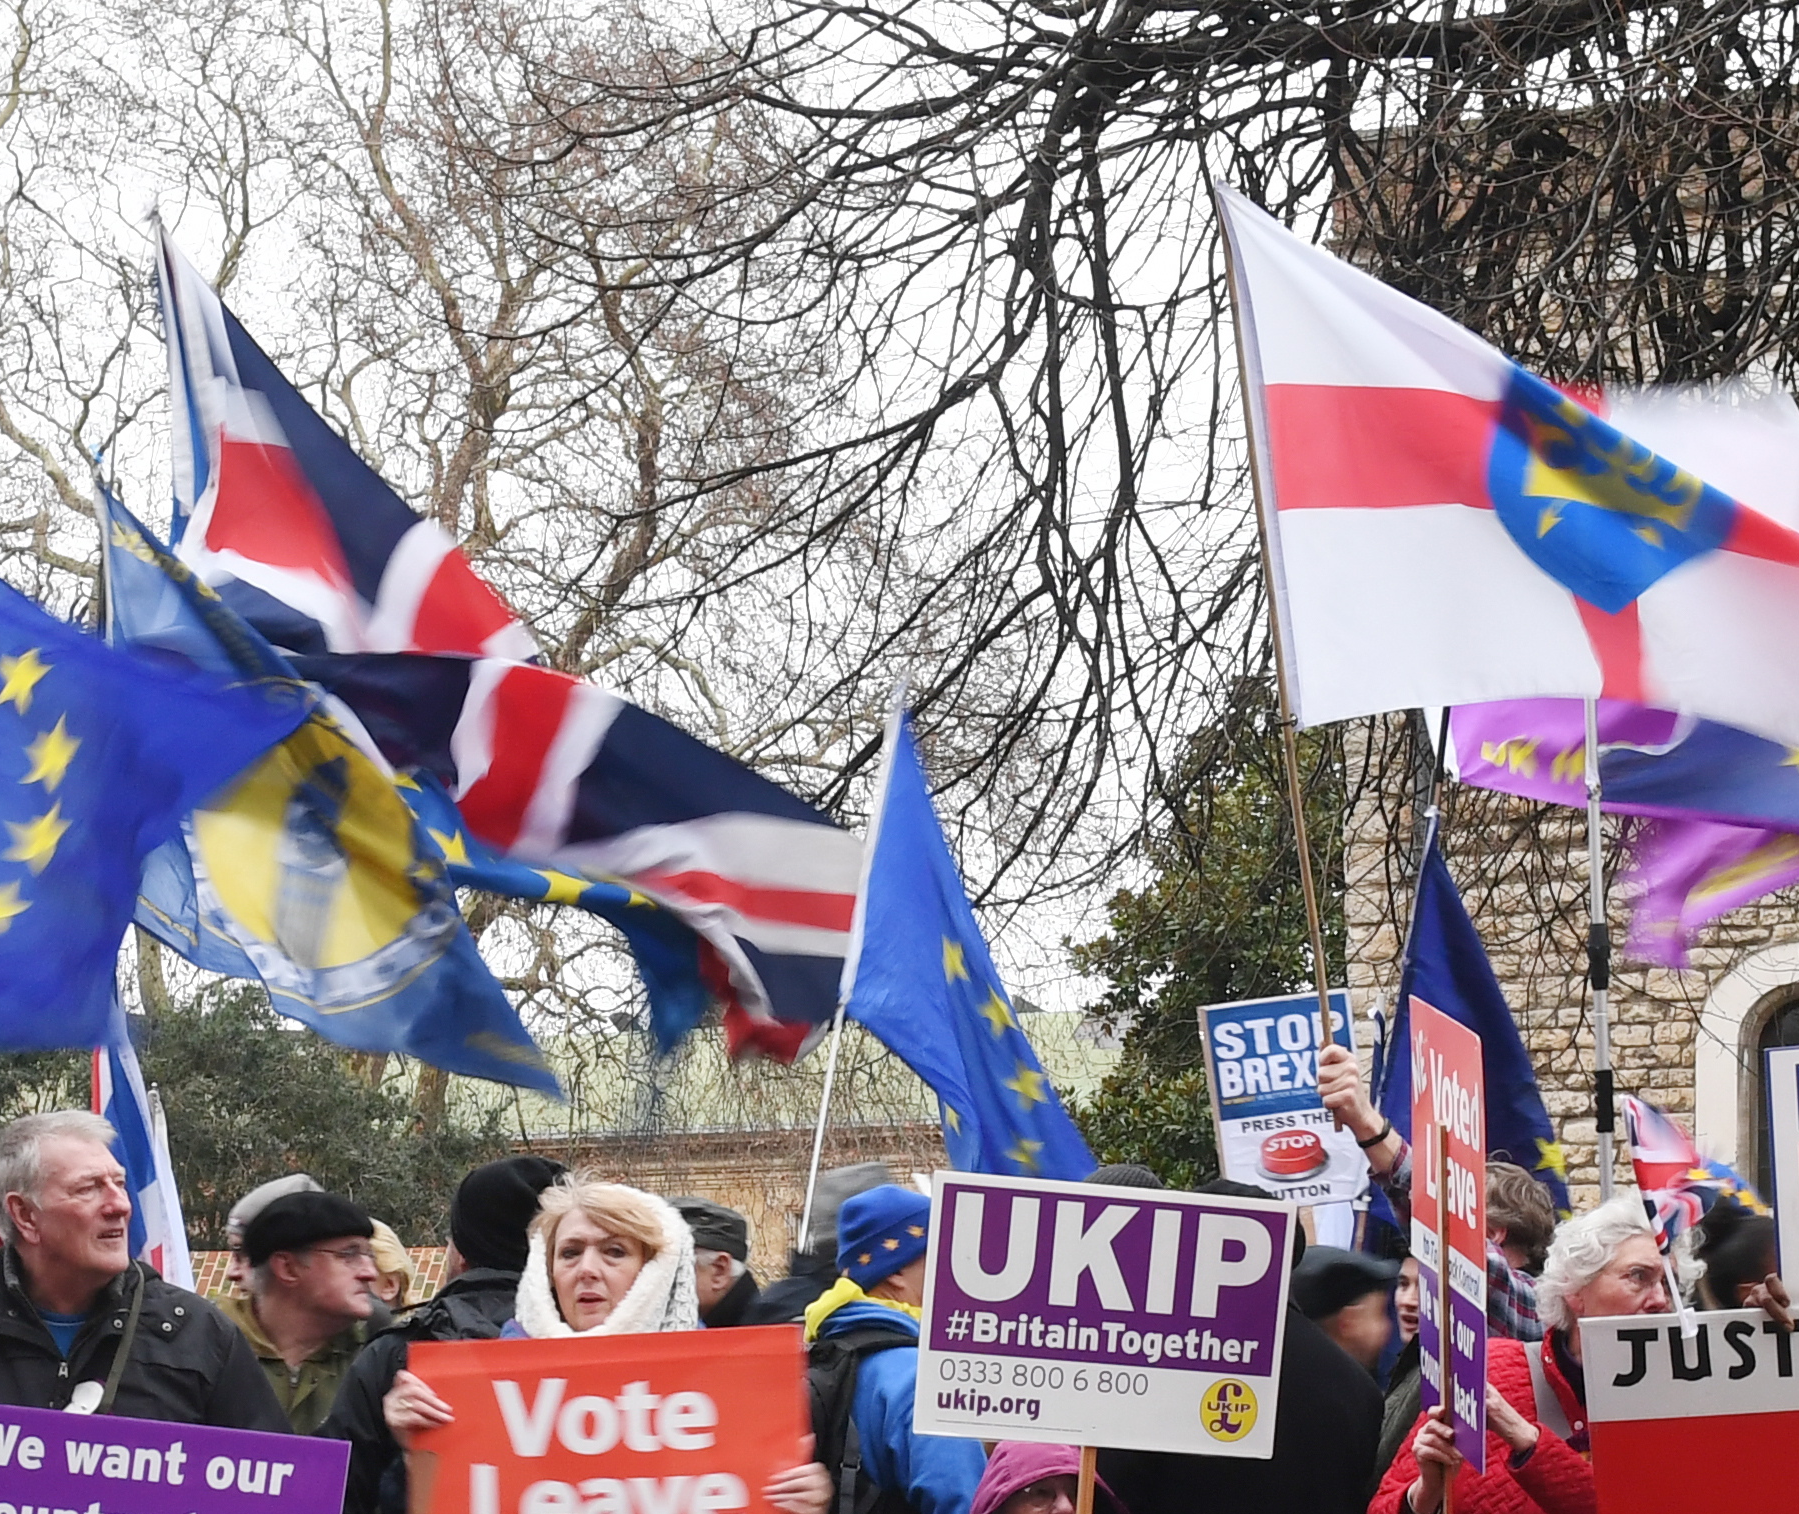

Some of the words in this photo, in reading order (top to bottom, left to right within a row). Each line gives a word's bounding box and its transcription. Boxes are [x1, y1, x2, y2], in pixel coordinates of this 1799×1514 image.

[1214, 1011, 1344, 1059] STOP
[1218, 1050, 1319, 1098] BREX
[1241, 1116, 1296, 1133] PRESS
[1302, 1110, 1334, 1125] THE
[1429, 1048, 1480, 1153] Voted
[1265, 1134, 1317, 1152] STOP
[1273, 1184, 1331, 1200] UTTON
[1426, 1123, 1477, 1229] Lave
[951, 1191, 1272, 1318] UKIP
[945, 1309, 1258, 1364] #BritainTogether
[1457, 1320, 1476, 1361] our
[939, 1358, 1002, 1384] 0333
[1012, 1364, 1064, 1390] 800
[1073, 1369, 1088, 1391] 6
[1097, 1371, 1148, 1395] 800
[492, 1377, 719, 1457] Vote
[937, 1388, 1041, 1421] ukip.org
[1207, 1402, 1251, 1413] UKIP
[1454, 1372, 1478, 1432] back
[65, 1440, 187, 1485] want
[206, 1455, 295, 1496] our
